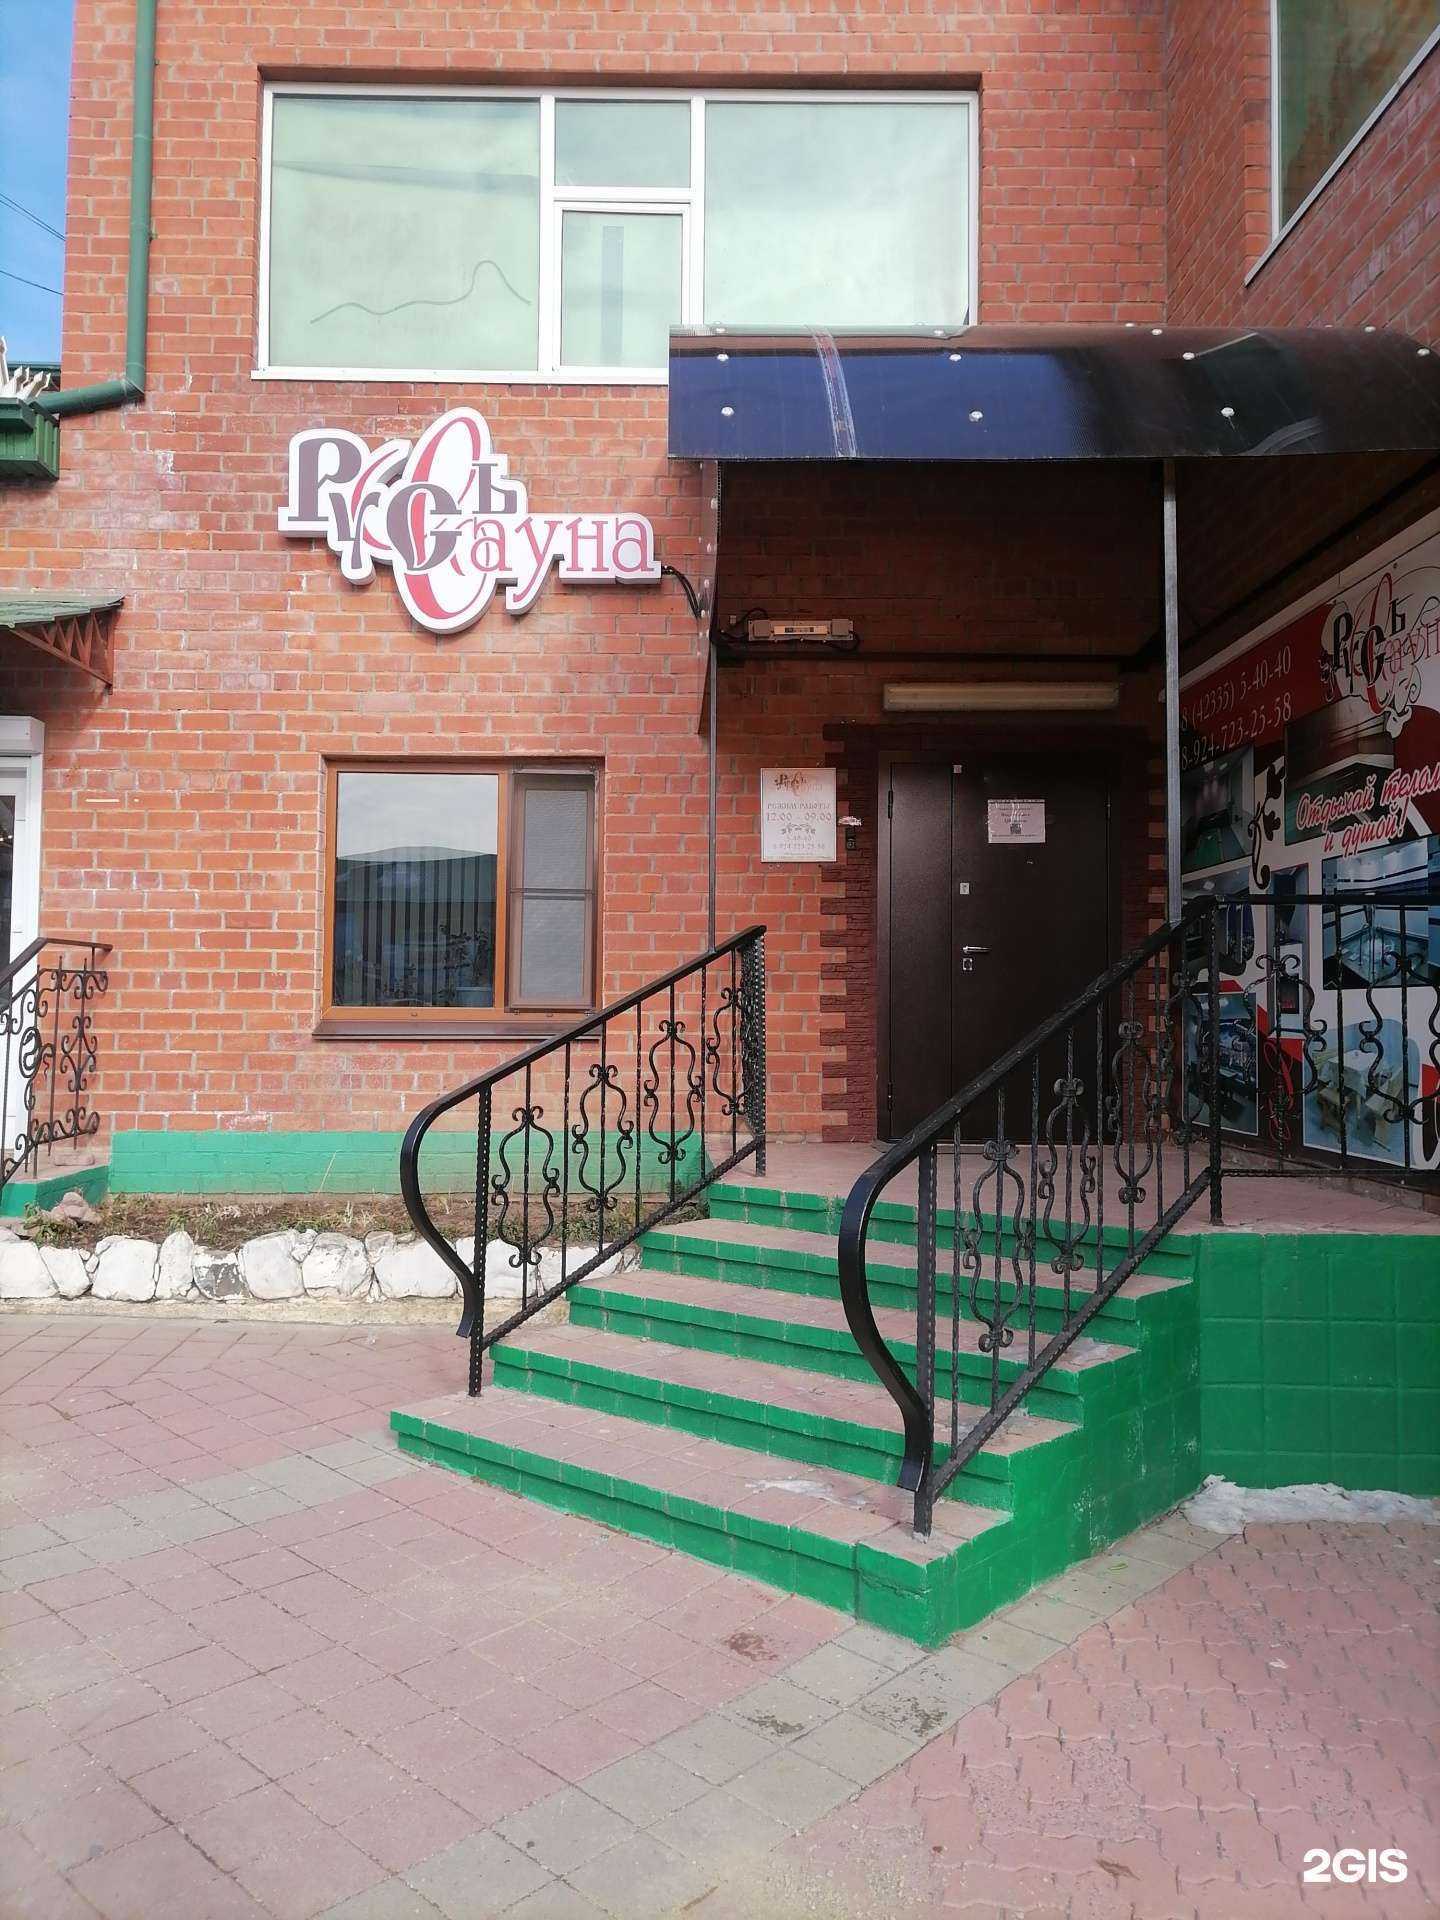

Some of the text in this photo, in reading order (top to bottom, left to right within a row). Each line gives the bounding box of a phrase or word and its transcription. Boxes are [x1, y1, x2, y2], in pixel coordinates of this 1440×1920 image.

[1240, 646, 1291, 700] 5-40-40
[1296, 774, 1378, 833] Отдыхай
[1324, 832, 1335, 852] и
